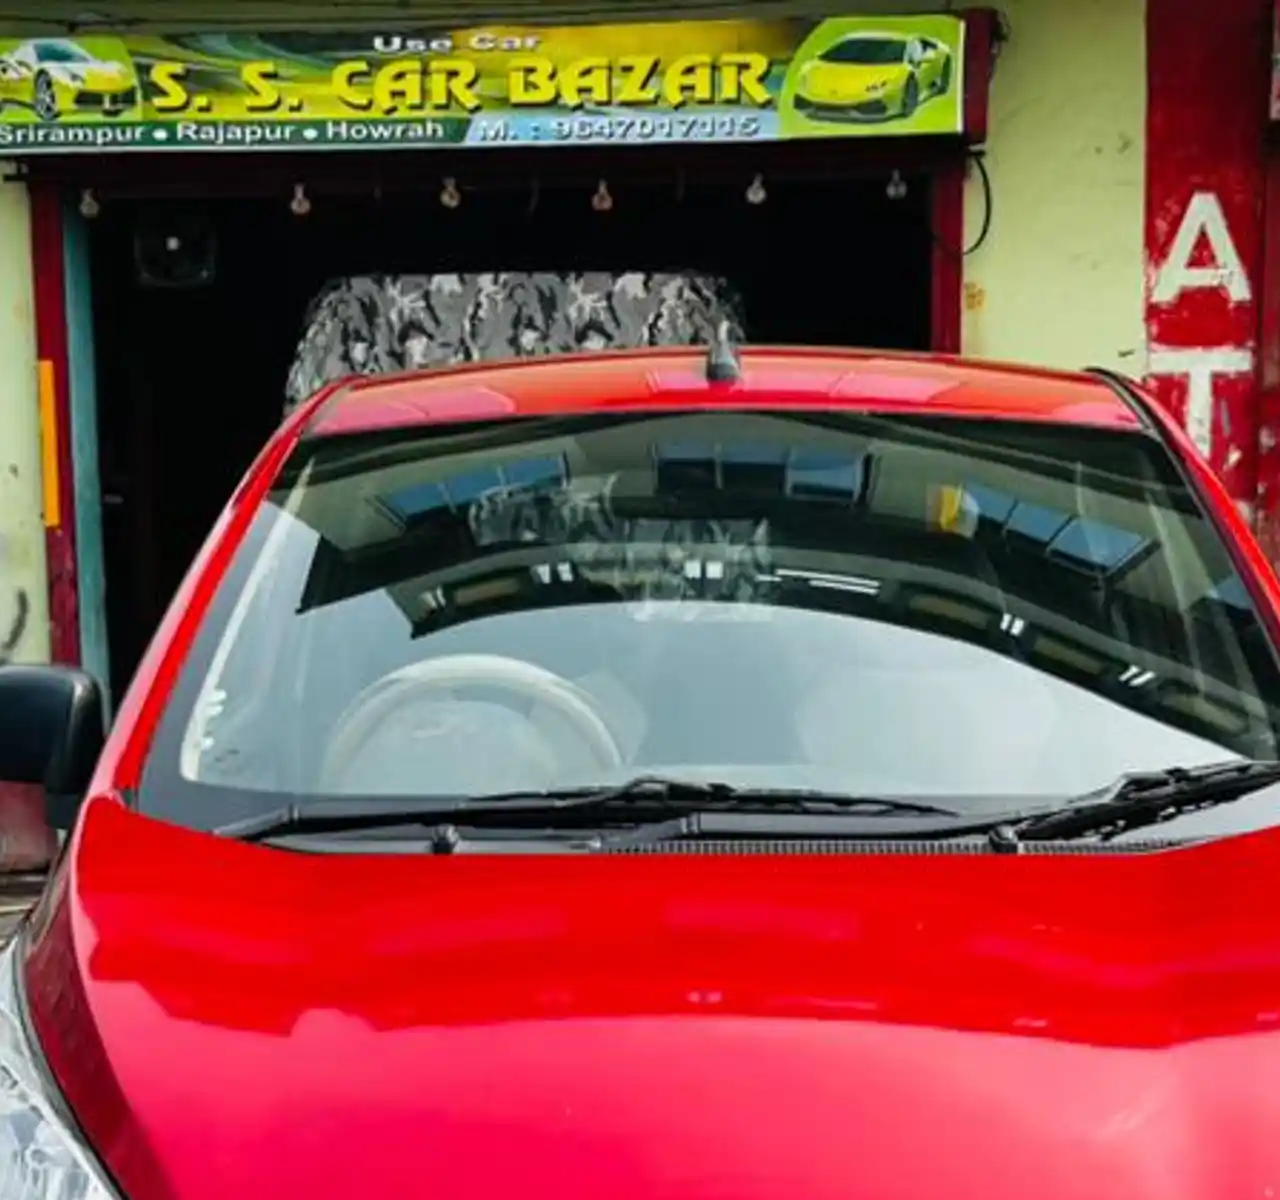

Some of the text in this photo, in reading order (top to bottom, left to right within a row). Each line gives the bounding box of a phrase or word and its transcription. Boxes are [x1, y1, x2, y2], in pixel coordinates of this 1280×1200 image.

[373, 33, 541, 54] Use Car
[150, 53, 773, 115] S. S. CAR BAZAR
[176, 121, 296, 143] Rajapur
[326, 119, 445, 140] Howrah
